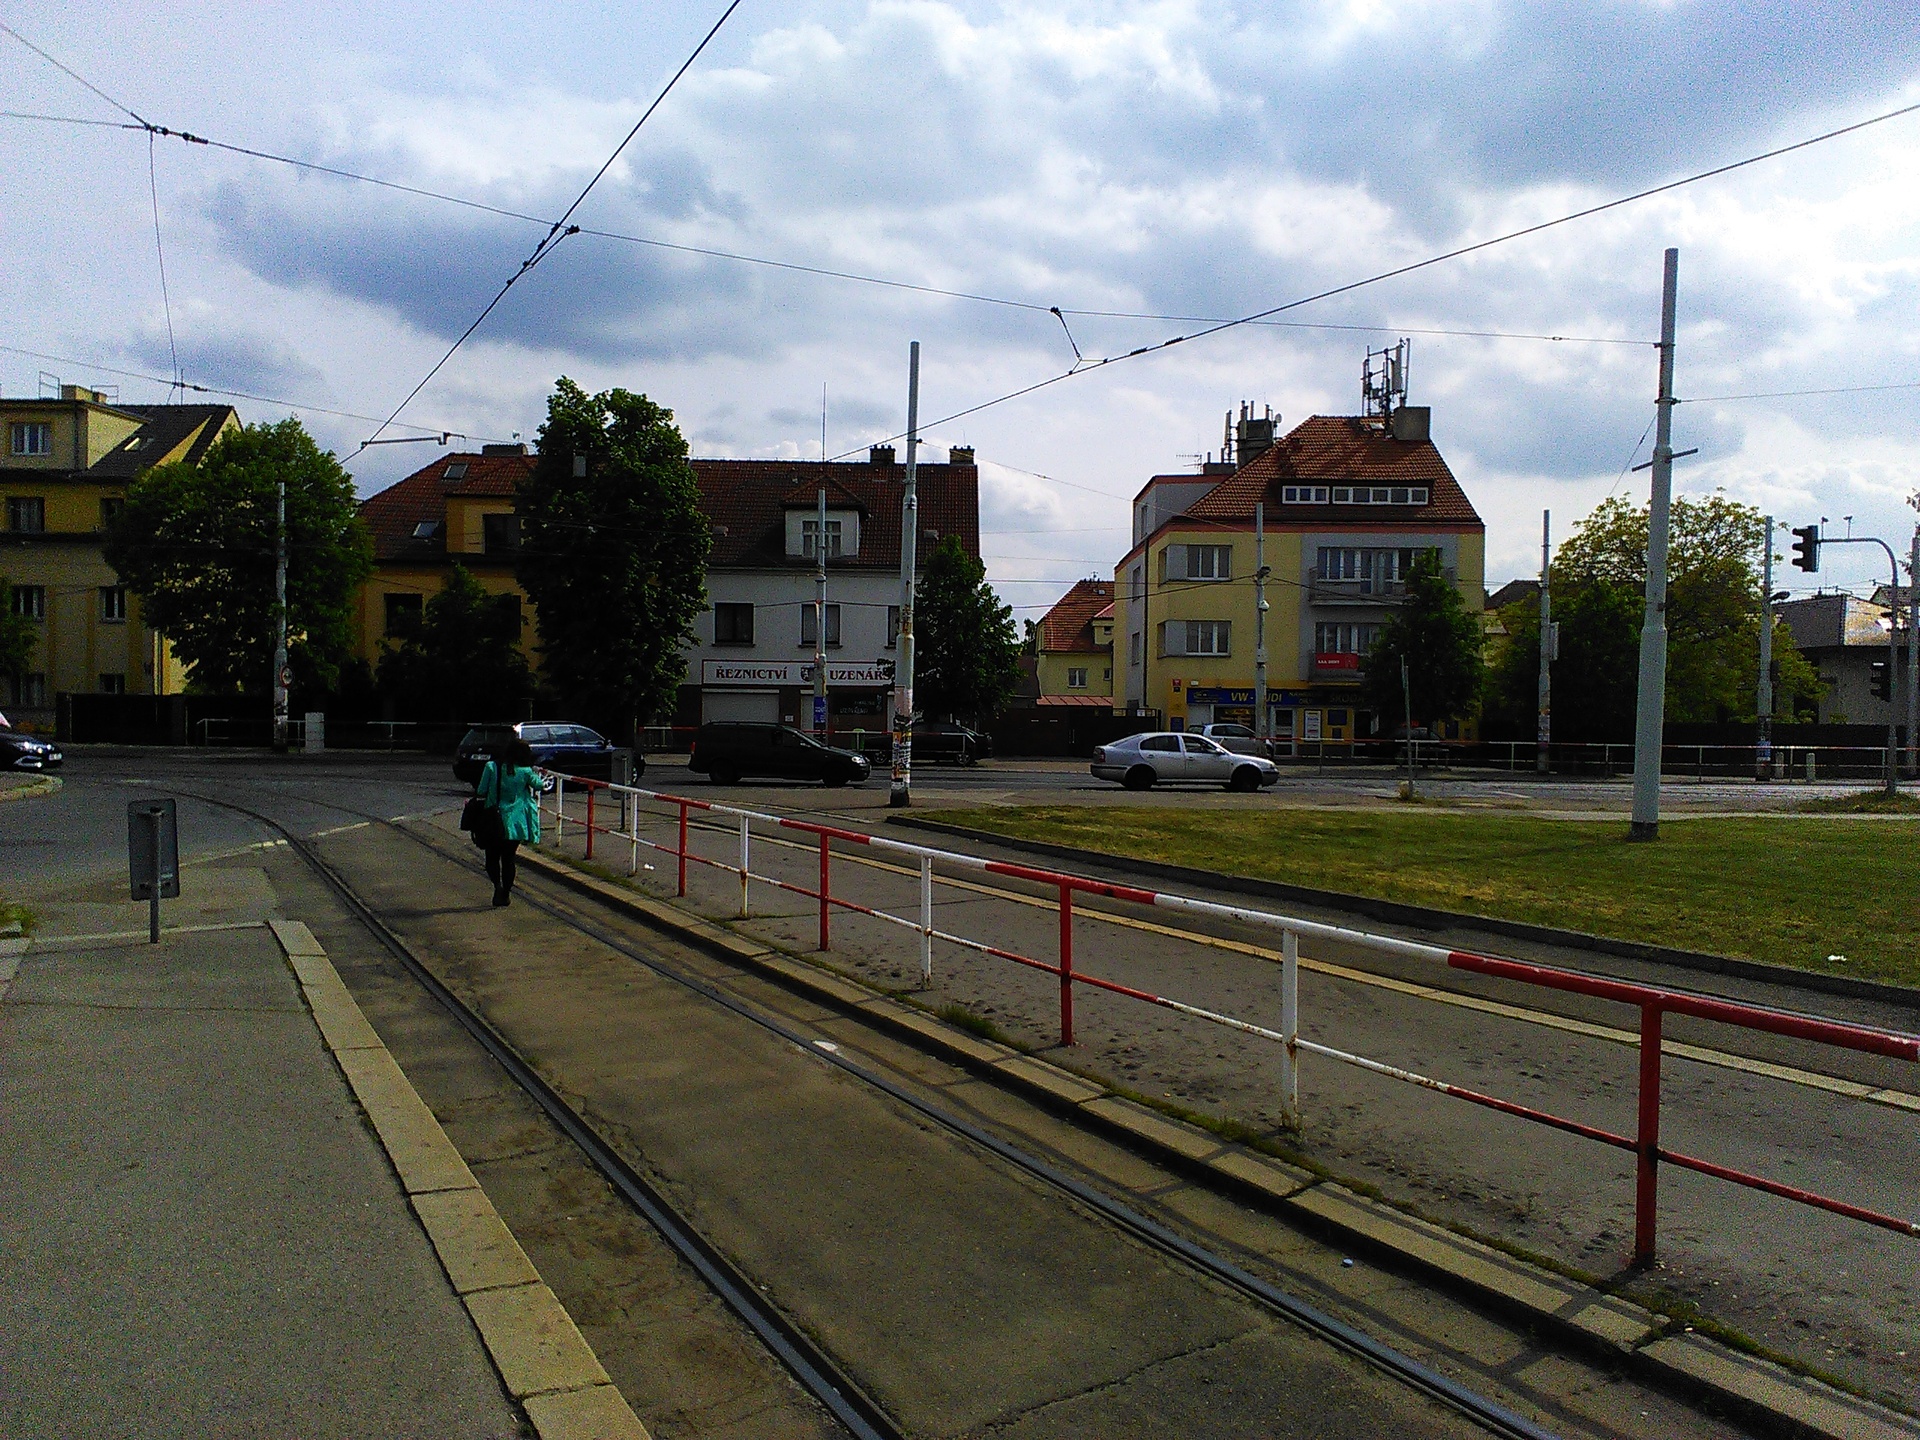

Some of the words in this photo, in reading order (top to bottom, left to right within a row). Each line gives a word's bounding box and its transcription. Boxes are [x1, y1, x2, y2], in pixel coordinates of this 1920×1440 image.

[716, 666, 788, 680] ŘEZNICTVÍ
[1231, 692, 1249, 702] VW
[1265, 692, 1283, 703] UDI
